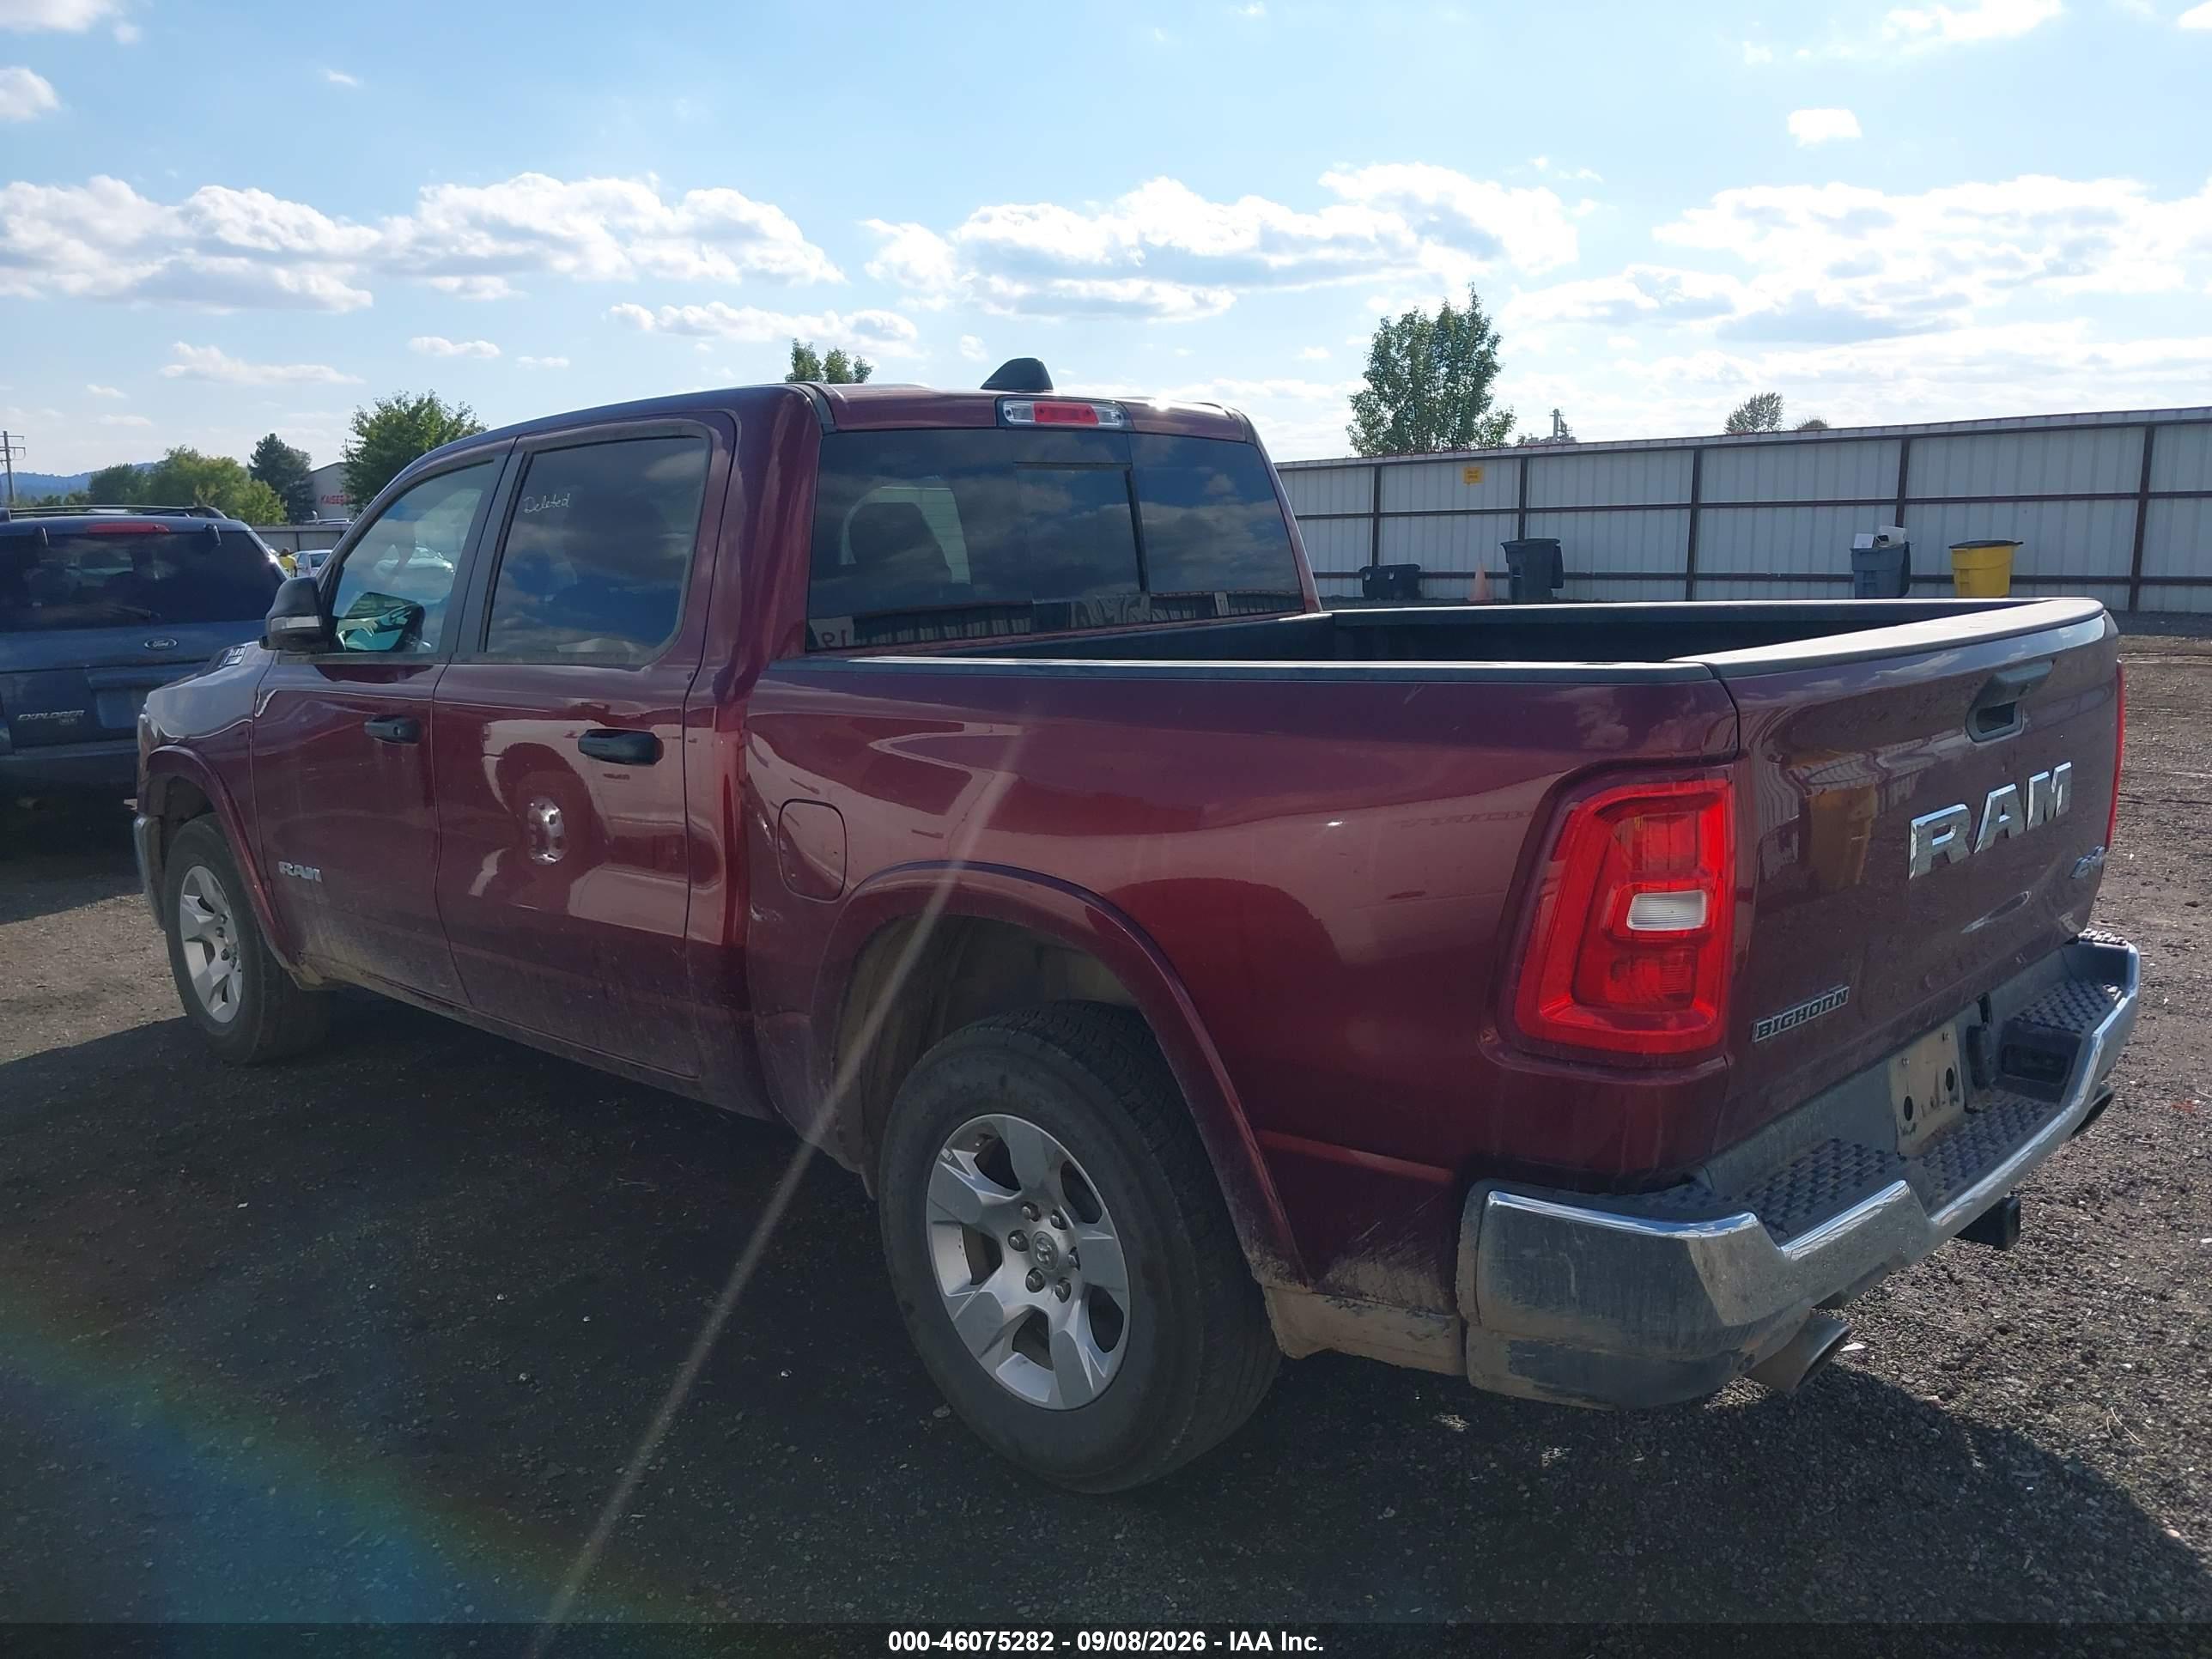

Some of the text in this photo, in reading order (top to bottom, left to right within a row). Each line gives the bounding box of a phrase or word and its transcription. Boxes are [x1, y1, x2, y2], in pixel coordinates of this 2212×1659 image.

[523, 493, 571, 514] Deleted
[18, 709, 85, 721] EXPLORER
[1908, 761, 2073, 881] RAM
[278, 860, 323, 883] RAM
[1753, 985, 1850, 1043] BIGHORN
